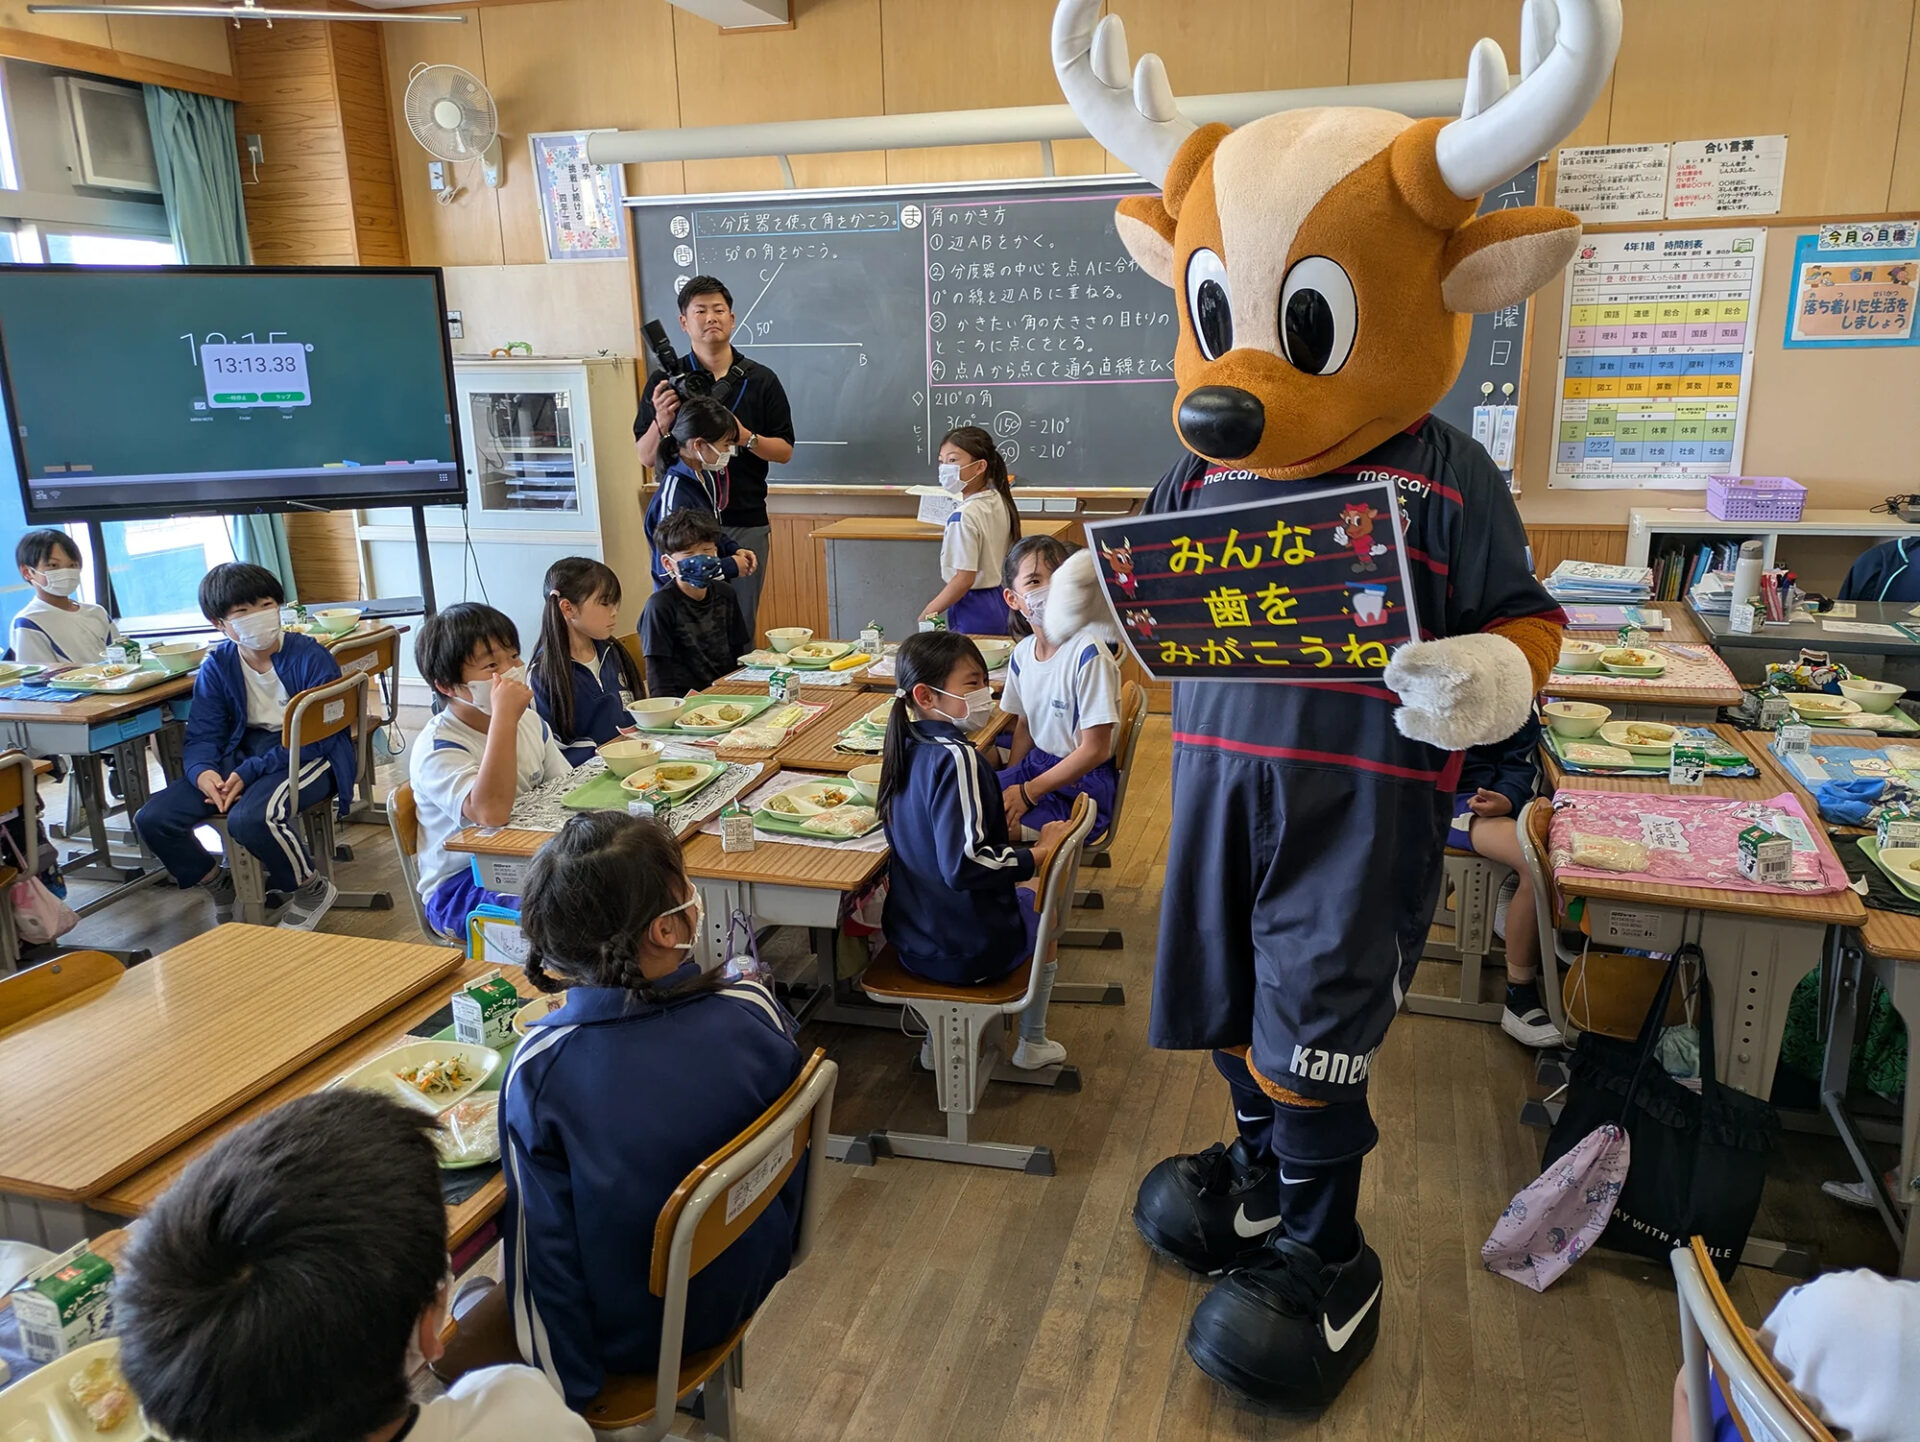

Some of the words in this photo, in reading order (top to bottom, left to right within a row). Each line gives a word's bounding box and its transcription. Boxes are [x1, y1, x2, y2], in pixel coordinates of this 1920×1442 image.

[1705, 140, 1754, 154] 合い言葉
[720, 211, 898, 234] 分度器を使って角をかこう。
[903, 206, 921, 227] ま
[930, 204, 1007, 228] 角のかき方
[672, 218, 689, 237] 課
[1828, 228, 1907, 243] 今月の目標
[676, 246, 693, 264] 問
[724, 242, 839, 262] 50°の角をかこう。
[1623, 241, 1655, 252] 4年1組
[1664, 239, 1703, 250] 時間割表
[1643, 263, 1650, 271] 火
[1734, 259, 1742, 267] 金
[1850, 267, 1873, 282] 6月
[1803, 297, 1909, 315] 落ち着いた生活を
[1841, 314, 1906, 330] しましょう
[935, 334, 1094, 355] ところに点Cをとる。
[1590, 441, 1610, 449] クラブ
[1168, 520, 1316, 575] みんな
[1203, 581, 1299, 629] 歯を
[1159, 633, 1391, 670] みがこうね
[1613, 1208, 1630, 1222] AY
[1632, 1219, 1669, 1242] WITH
